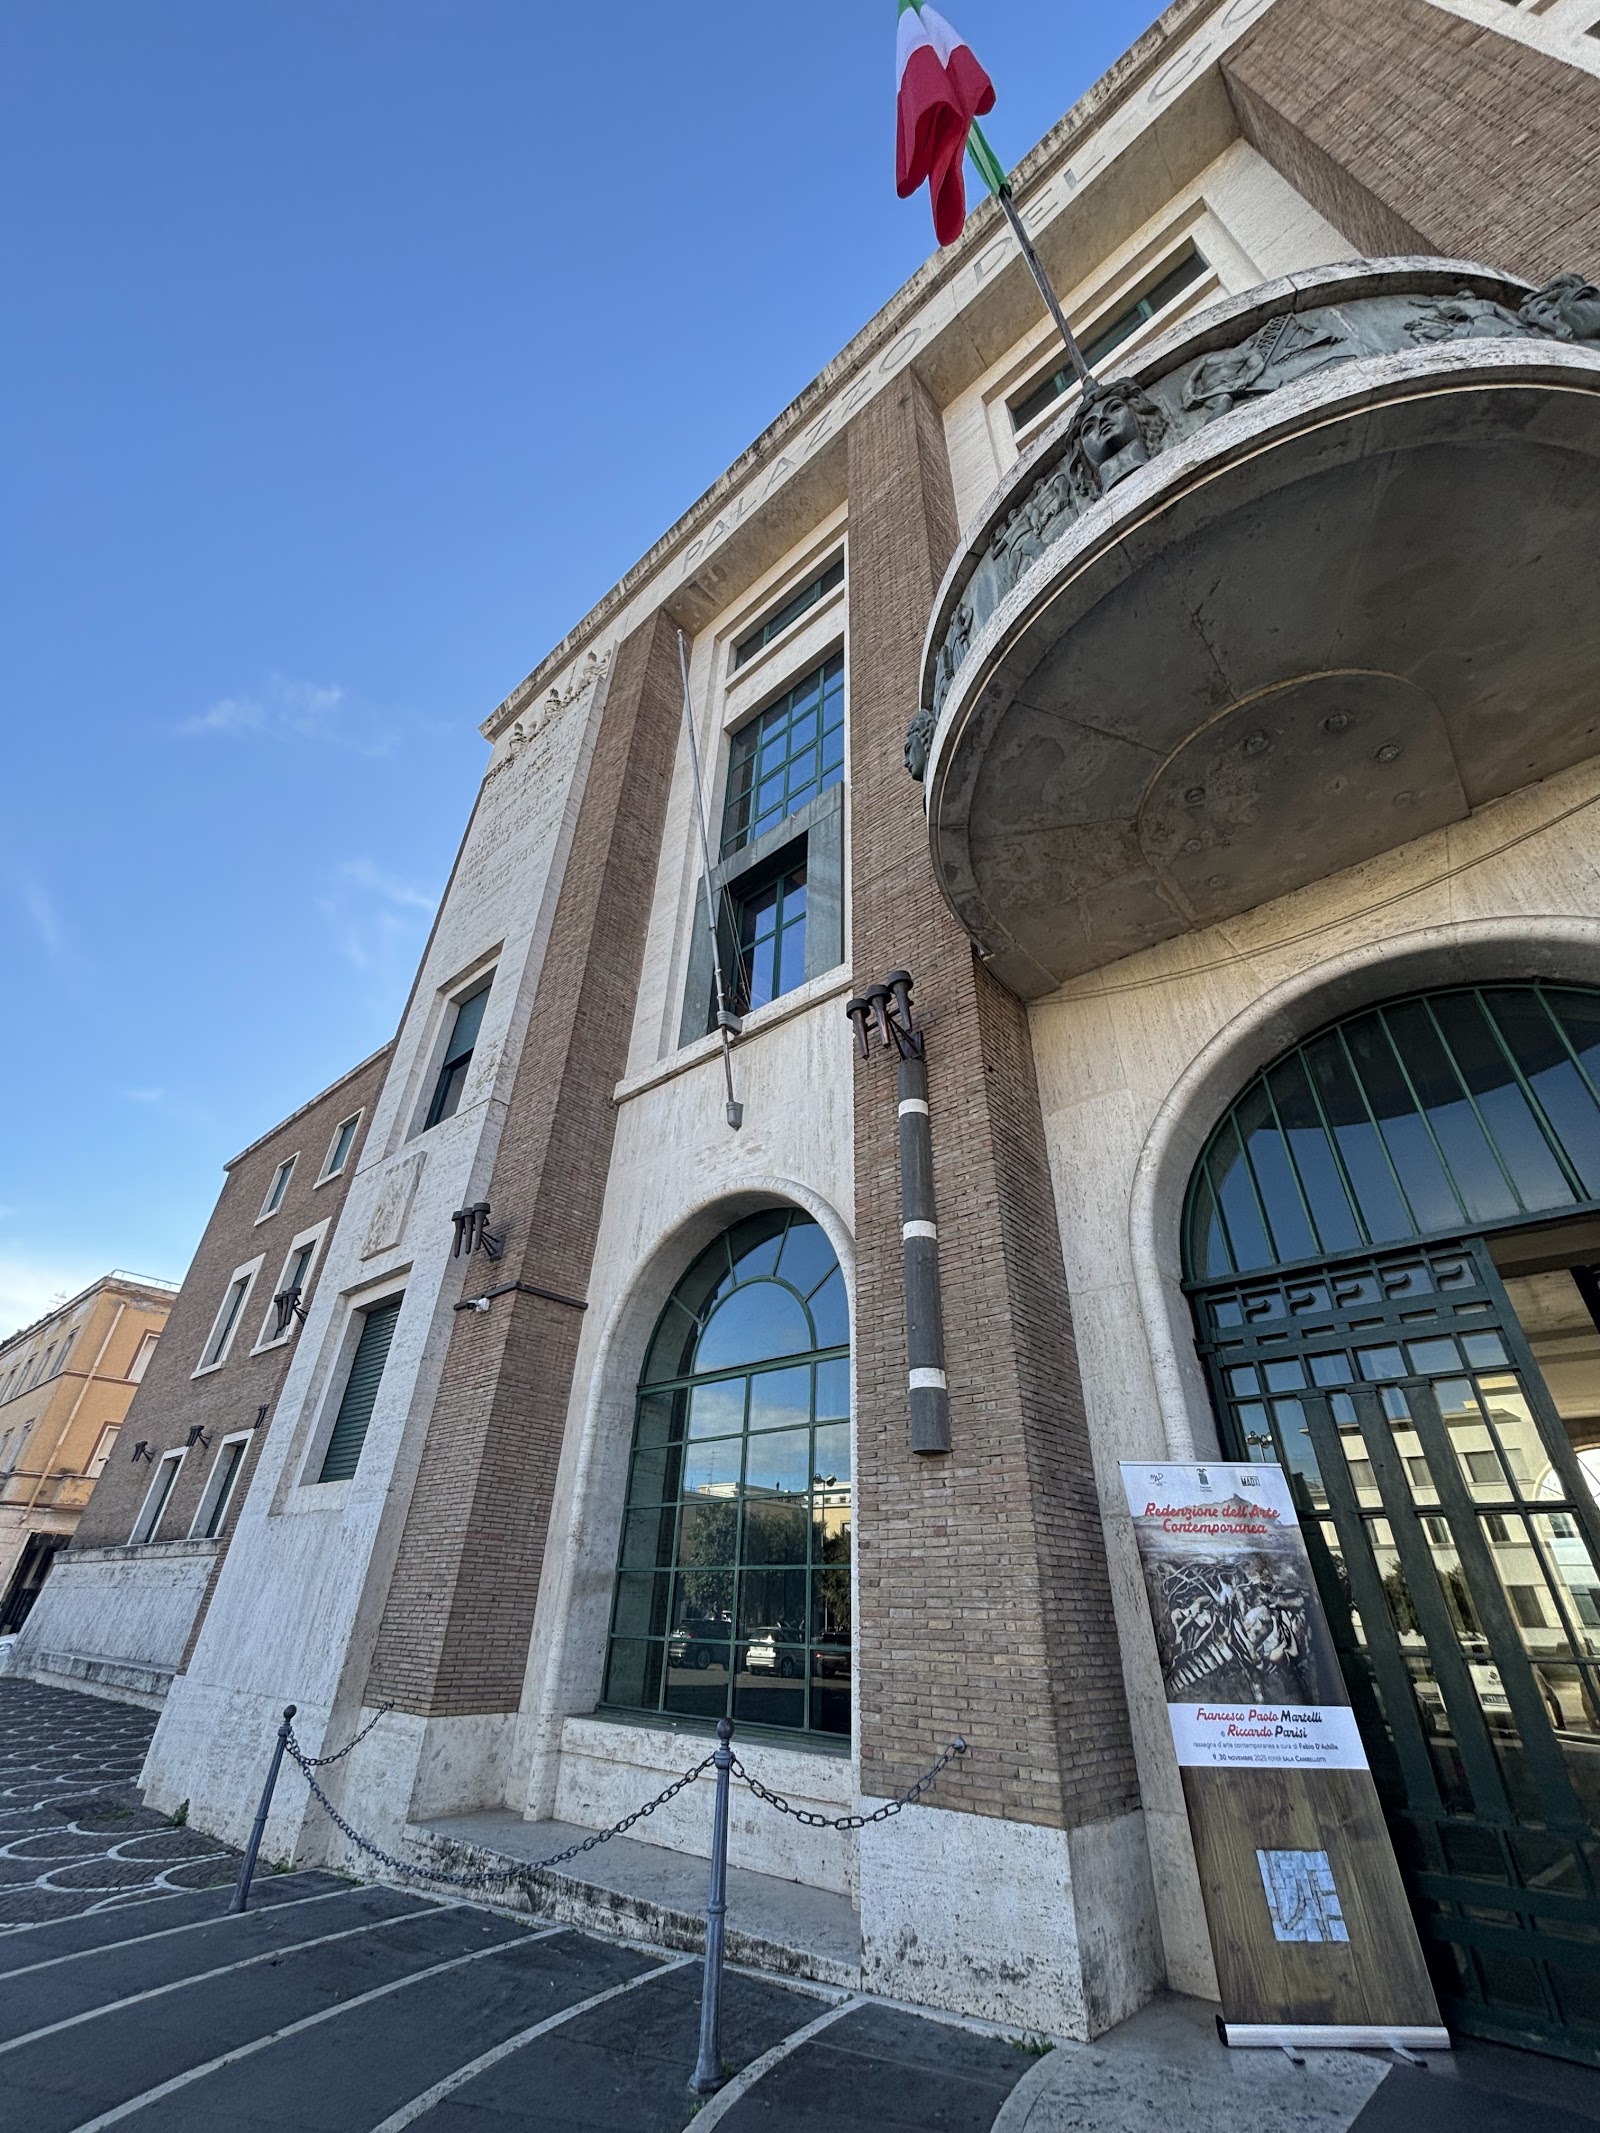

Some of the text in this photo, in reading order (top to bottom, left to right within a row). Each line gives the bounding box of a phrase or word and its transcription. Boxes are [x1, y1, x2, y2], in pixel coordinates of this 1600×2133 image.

[681, 327, 922, 575] PALAZZO
[973, 154, 1107, 286] DEL
[1145, 1502, 1218, 1521] Redenzione
[1163, 1518, 1268, 1536] Contemporanea
[1196, 1707, 1323, 1723] Francesco Paolo Martelli
[1227, 1723, 1273, 1738] Riccardo
[1274, 1724, 1308, 1739] Parisi
[1299, 1742, 1315, 1750] Fabio
